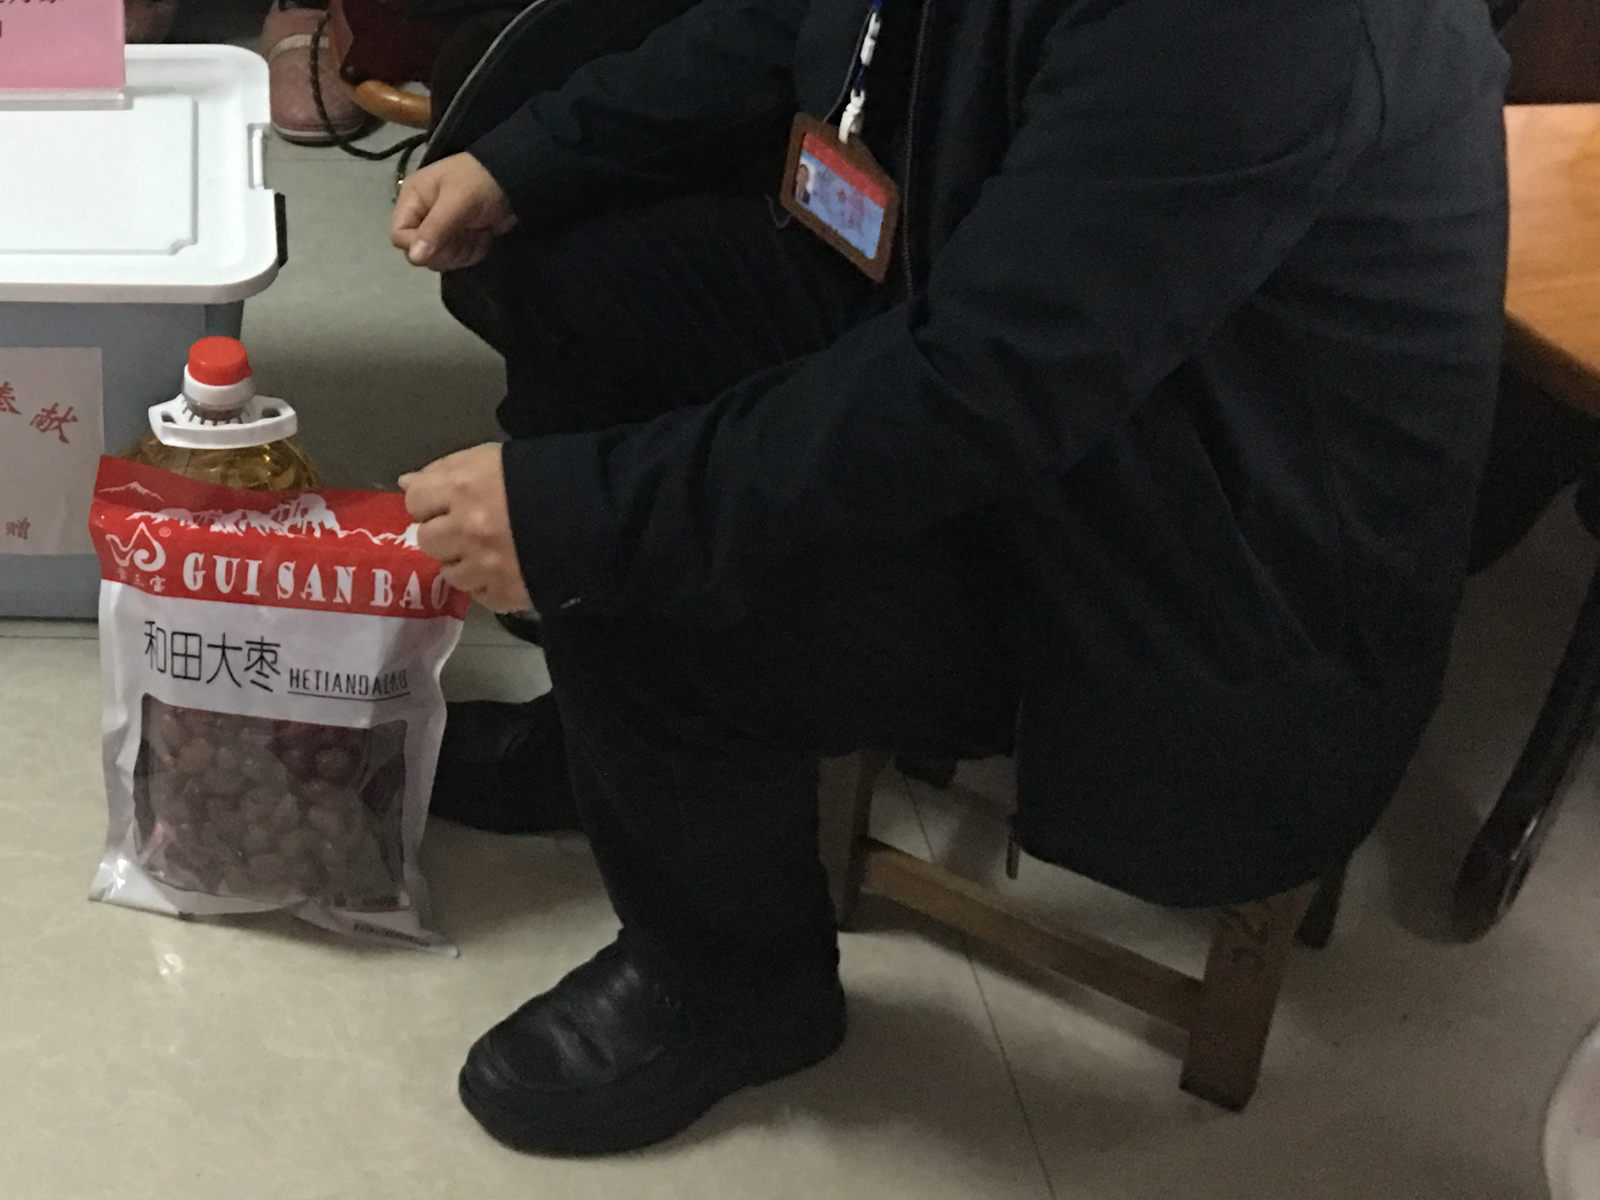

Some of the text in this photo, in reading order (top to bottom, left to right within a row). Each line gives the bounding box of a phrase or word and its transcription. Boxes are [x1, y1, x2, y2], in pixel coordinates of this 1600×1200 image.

[183, 552, 450, 610] GUI SAN BAO
[143, 620, 282, 694] 和田大枣
